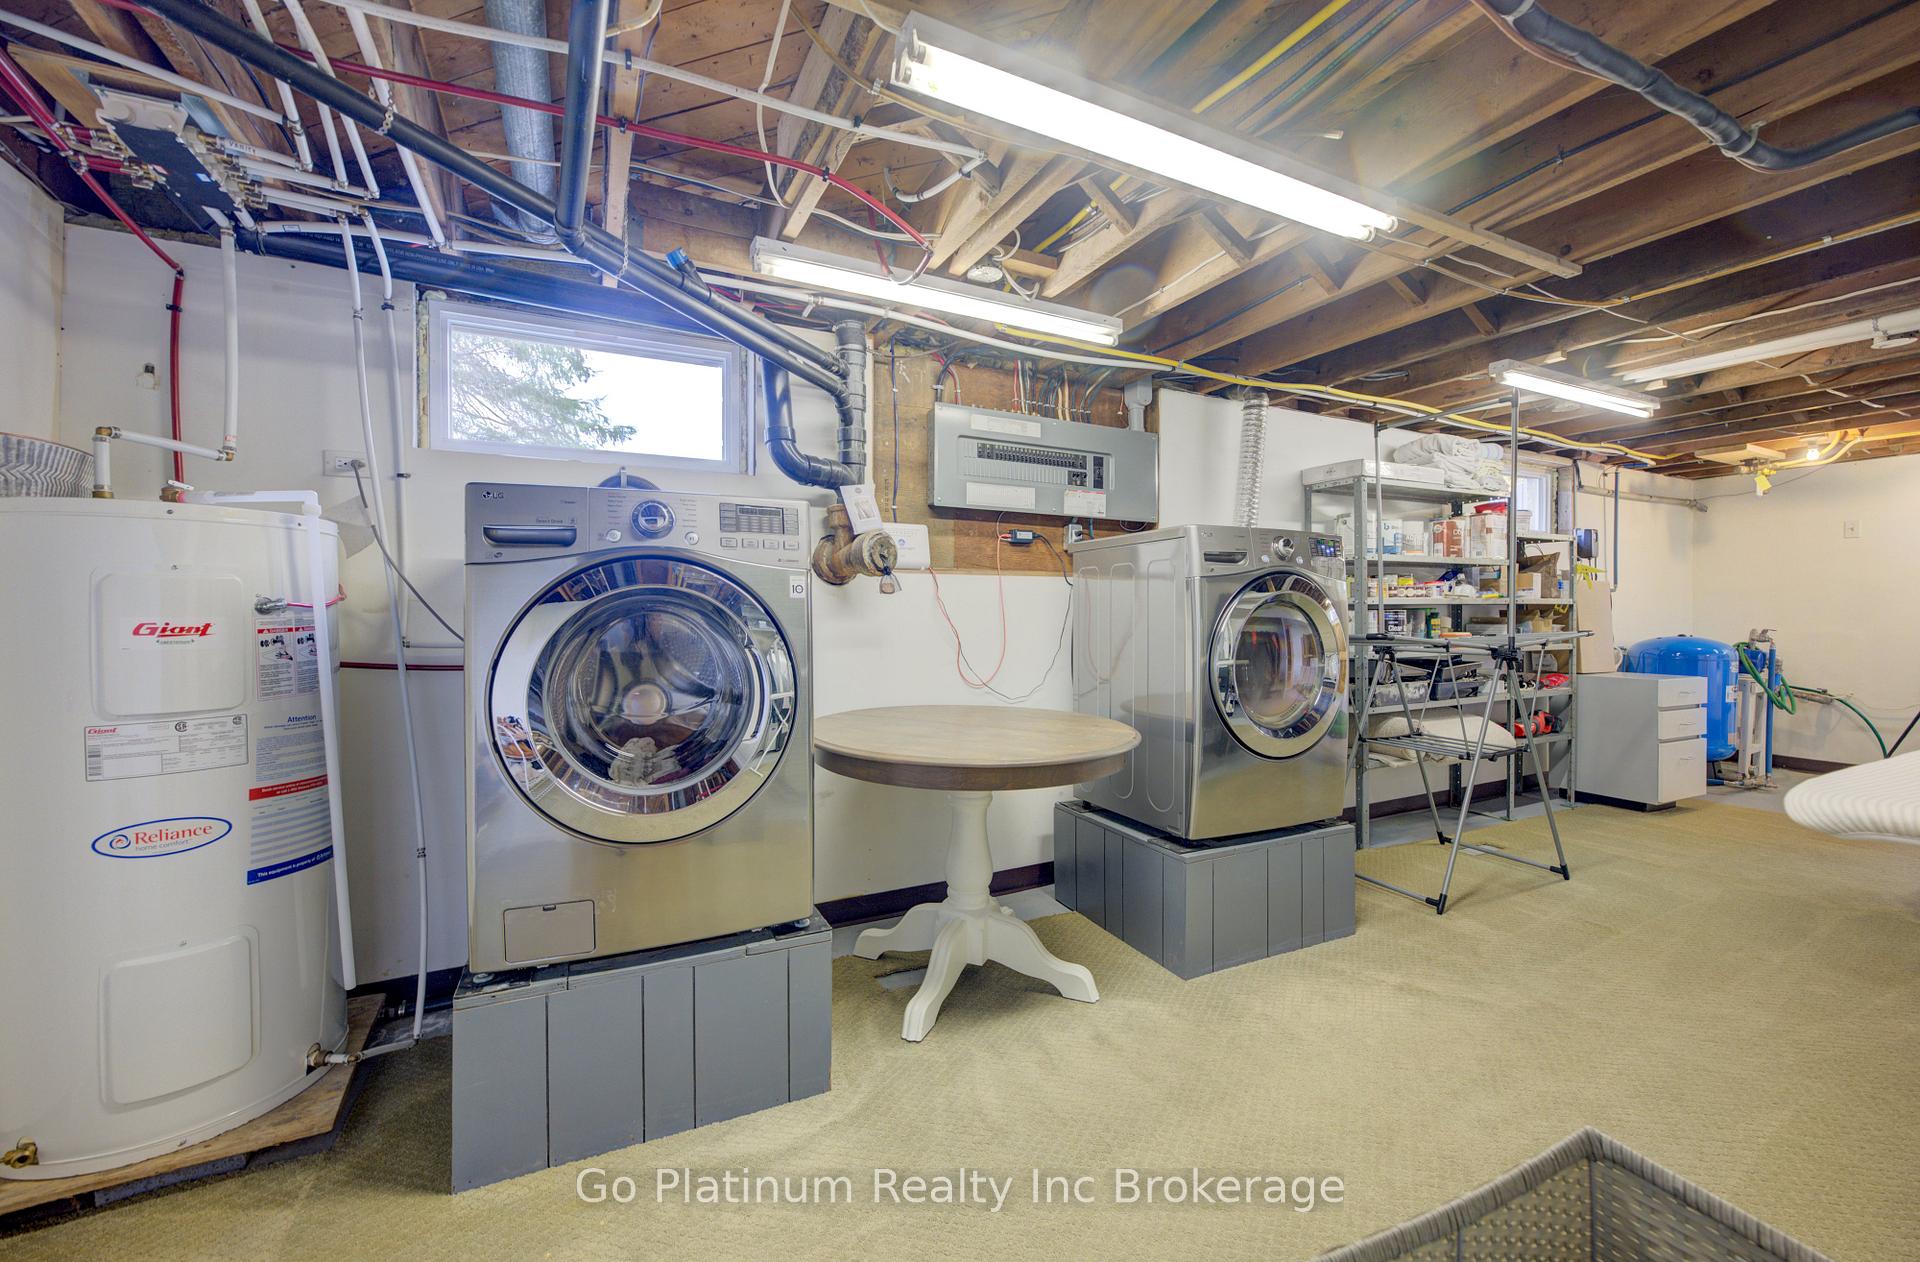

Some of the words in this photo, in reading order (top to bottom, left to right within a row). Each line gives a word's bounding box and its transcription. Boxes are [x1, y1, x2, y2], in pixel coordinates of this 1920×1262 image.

[132, 622, 216, 638] Giant
[287, 714, 317, 723] Attention
[135, 824, 213, 845] Reliance
